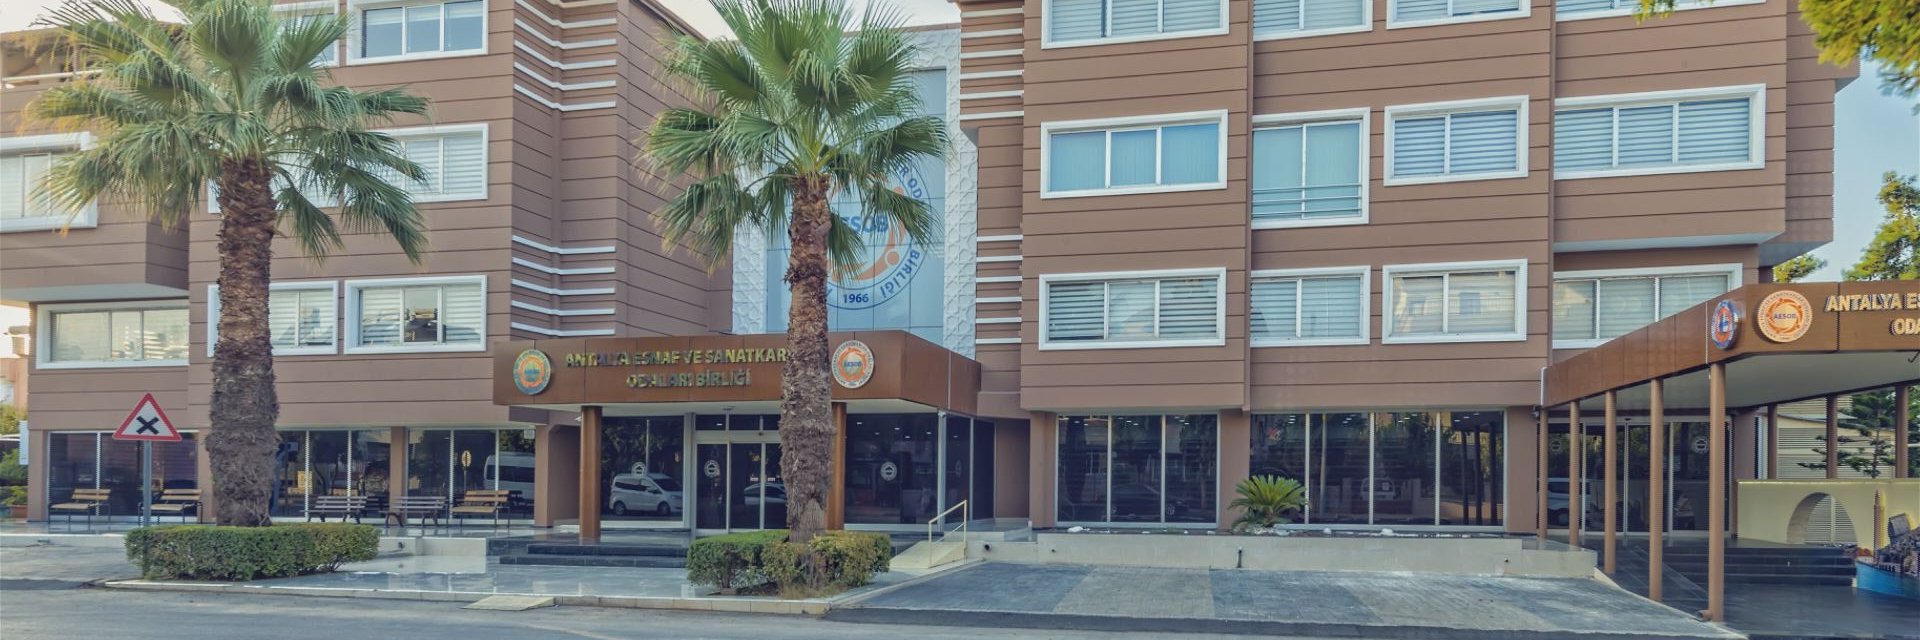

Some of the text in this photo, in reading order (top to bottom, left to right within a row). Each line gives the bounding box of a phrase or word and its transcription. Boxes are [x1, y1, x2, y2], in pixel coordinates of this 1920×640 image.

[843, 293, 869, 304] 1966
[1825, 293, 1903, 313] ANTALYA
[632, 350, 681, 365] ESNAF
[683, 350, 702, 364] VE
[705, 347, 787, 363] SANATKAR
